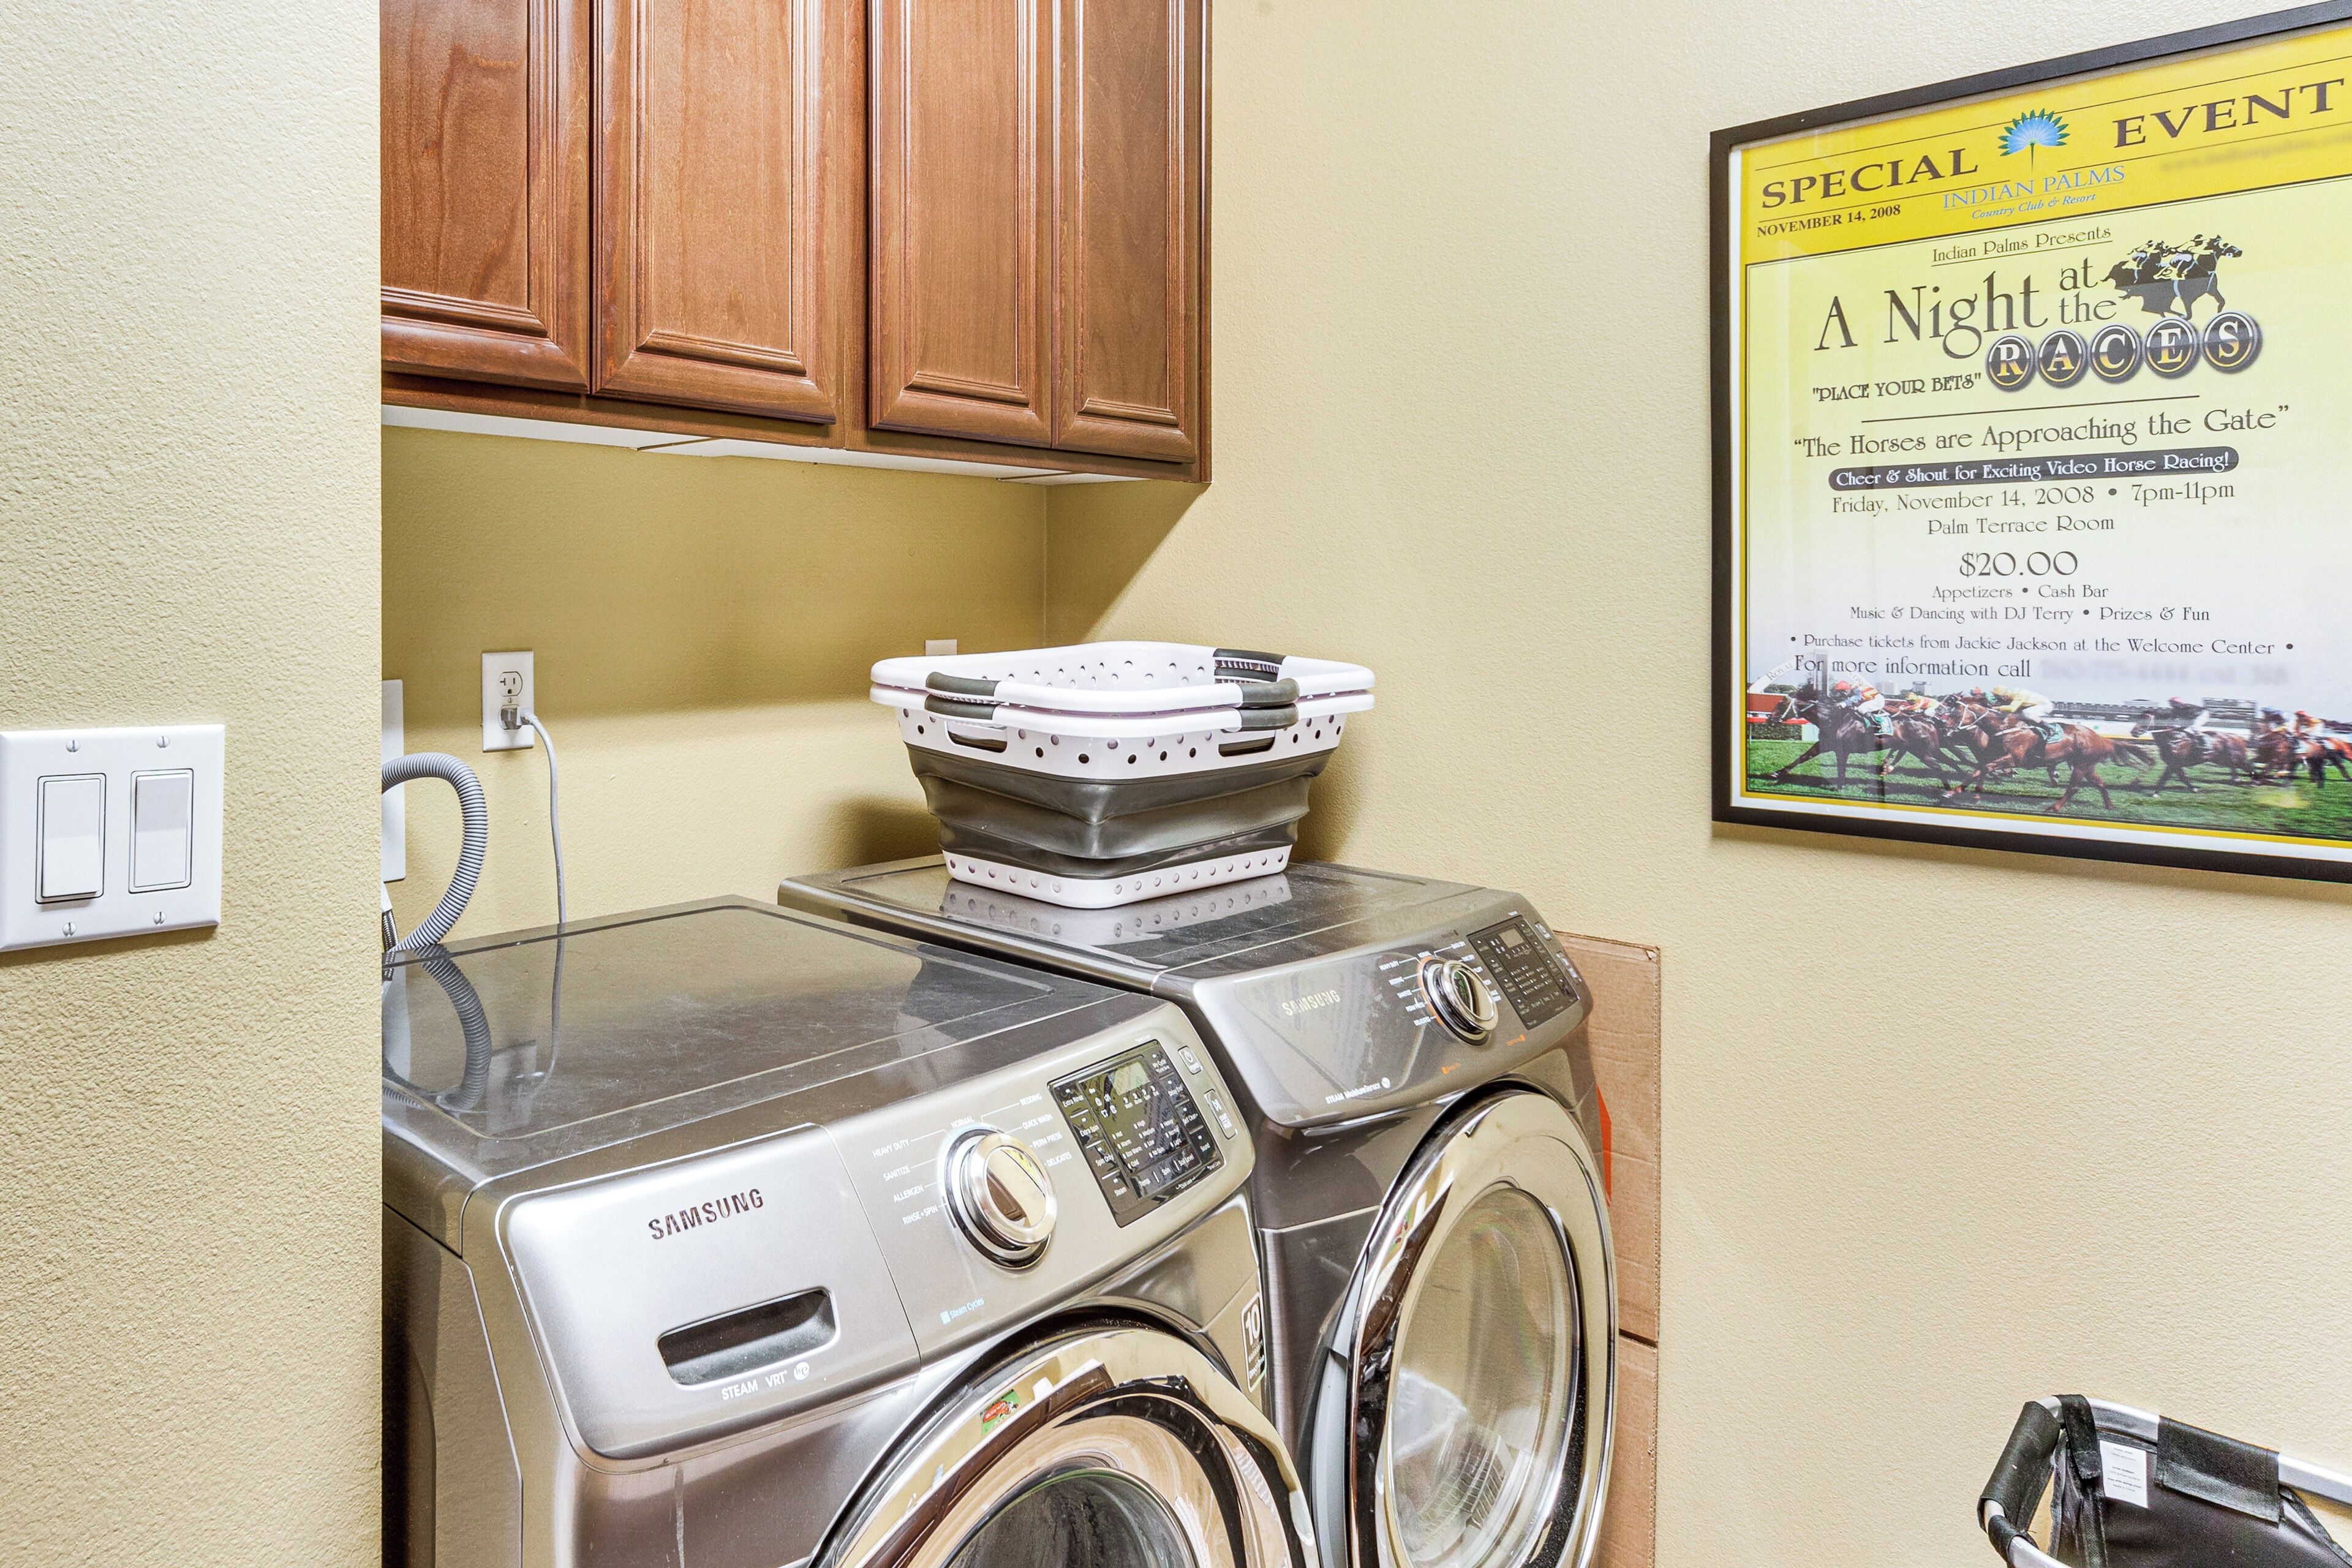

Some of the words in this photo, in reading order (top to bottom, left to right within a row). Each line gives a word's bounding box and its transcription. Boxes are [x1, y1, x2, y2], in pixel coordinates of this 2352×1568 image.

[1762, 148, 1978, 209] SPECIAL
[2112, 78, 2345, 148] EVENT
[1943, 179, 2035, 209] INDIAN
[2044, 165, 2125, 193] PALMS
[1971, 207, 2015, 219] Country
[2018, 200, 2045, 212] Club
[2047, 198, 2059, 208] &
[2062, 194, 2096, 205] Resort
[1757, 214, 1842, 237] NOVEMBER
[1849, 211, 1865, 222] 14,
[1870, 205, 1901, 219] 2008
[1932, 246, 1977, 262] Indian
[1983, 238, 2029, 255] Palms
[2036, 227, 2111, 247] Presents
[2060, 257, 2098, 290] at
[1814, 296, 1858, 350] A
[1884, 271, 2049, 360] Night
[2059, 292, 2116, 324] the
[1993, 317, 2244, 381] RACES
[1813, 383, 1869, 401] "PLACE
[1874, 379, 1925, 396] YOUR
[1932, 372, 1981, 391] BETS"
[1795, 437, 1840, 457] “The
[1850, 435, 1926, 454] Horses
[1936, 434, 1972, 449] are
[1981, 418, 2137, 451] Approaching
[2149, 412, 2191, 435] the
[2204, 405, 2288, 431] Gate”
[1836, 472, 1881, 486] Cheer
[1887, 470, 1900, 483] &
[1905, 468, 1949, 482] Shout
[1955, 465, 1977, 480] for
[1983, 464, 2041, 481] Exciting
[2046, 459, 2097, 475] Video
[2104, 458, 2155, 472] Horse
[2163, 451, 2230, 473] Racing!
[1833, 496, 1888, 517] Friday,
[1898, 491, 1992, 510] November
[2003, 490, 2025, 506] 14,
[2035, 486, 2094, 504] 2008
[2132, 481, 2234, 507] 7pm-11pm
[1928, 519, 1968, 534] Palm
[1977, 518, 2047, 533] Terrace
[2057, 516, 2114, 530] Room
[1959, 551, 2078, 578] $20.00
[1932, 586, 2013, 602] Appetizers
[2038, 584, 2075, 597] Cash
[2083, 585, 2108, 597] Bar
[1851, 607, 1885, 619] Music
[1891, 606, 1904, 619] &
[1910, 607, 1965, 624] Dancing
[1970, 606, 1997, 619] with
[2005, 607, 2026, 619] DJ
[2033, 607, 2073, 624] Terry
[2100, 607, 2152, 620] Prizes
[2160, 607, 2175, 620] &
[2184, 607, 2209, 620] Fun
[1804, 634, 1863, 647] Purchase
[1869, 635, 1914, 647] tickets
[1920, 635, 1950, 648] from
[1955, 636, 2000, 649] Jackie
[2007, 637, 2067, 650] Jackson
[2074, 638, 2089, 651] at
[2095, 638, 2120, 651] the
[2128, 638, 2203, 652] Welcome
[2212, 640, 2274, 654] Center
[1795, 655, 1824, 671] For
[1833, 662, 1877, 673] more
[1886, 656, 1988, 676] information
[1998, 659, 2030, 677] call
[1281, 990, 1340, 1016] SAMSUNG
[1325, 1092, 1344, 1104] STEAM
[951, 1115, 975, 1128] NORMAL
[1022, 1119, 1038, 1130] QUICK
[1039, 1113, 1053, 1124] WASH
[872, 1144, 892, 1158] HEAVY
[894, 1138, 910, 1150] DUTY
[1033, 1138, 1047, 1148] PERM
[1048, 1132, 1063, 1143] PRESS
[1047, 1152, 1072, 1167] DELICATES
[883, 1165, 911, 1182] SANITIZE
[893, 1185, 924, 1203] ALLERGEN
[648, 1189, 764, 1240] SAMSUNG
[950, 1306, 968, 1319] Steam
[967, 1298, 984, 1311] Cycles
[1245, 1303, 1261, 1346] 10
[722, 1379, 759, 1400] STEAM
